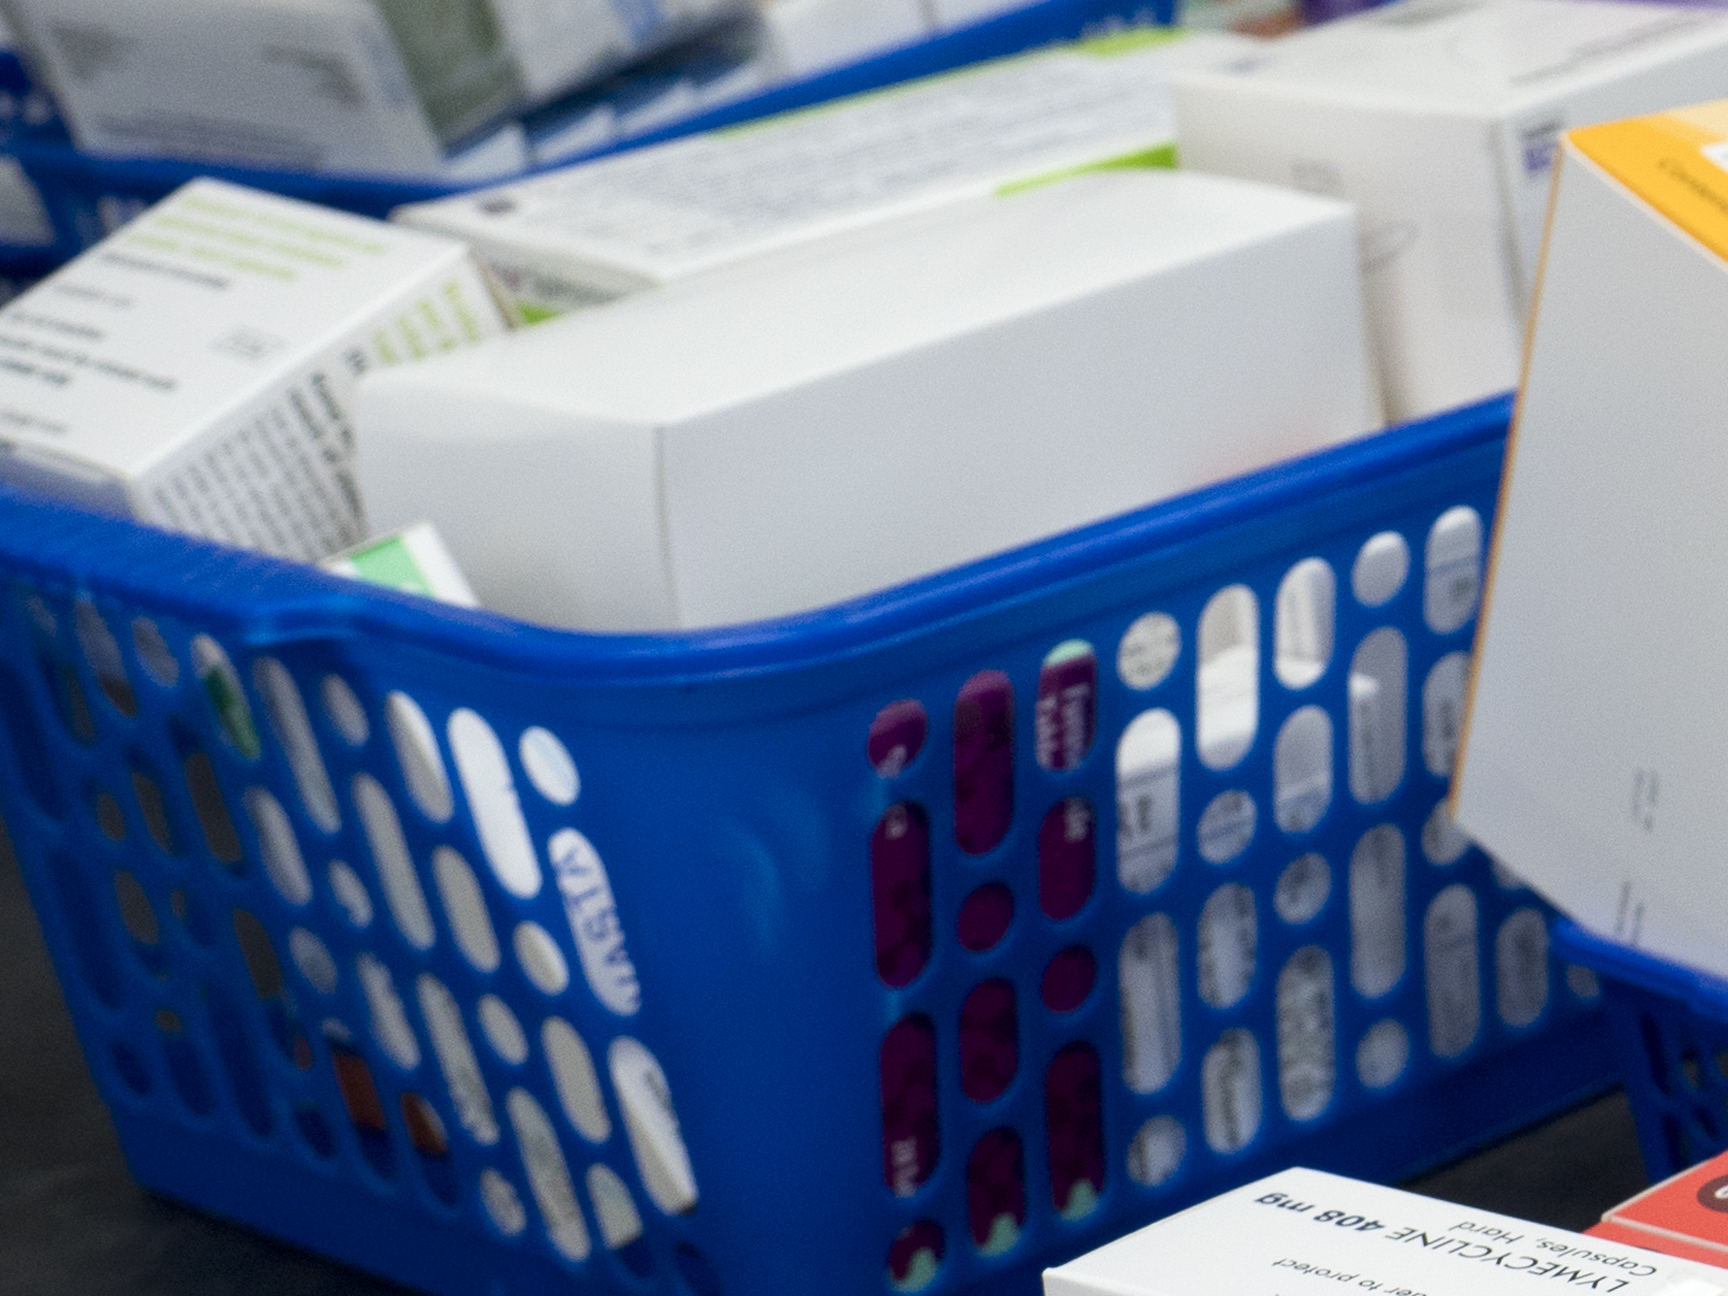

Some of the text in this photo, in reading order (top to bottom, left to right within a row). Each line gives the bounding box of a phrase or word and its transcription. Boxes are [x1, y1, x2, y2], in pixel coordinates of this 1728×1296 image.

[1252, 1190, 1631, 1294] LYMECYCLINE 408 mg
[1446, 1219, 1659, 1278] Capsules, Hard
[1269, 1256, 1361, 1283] protect
[1356, 1278, 1384, 1292] to
